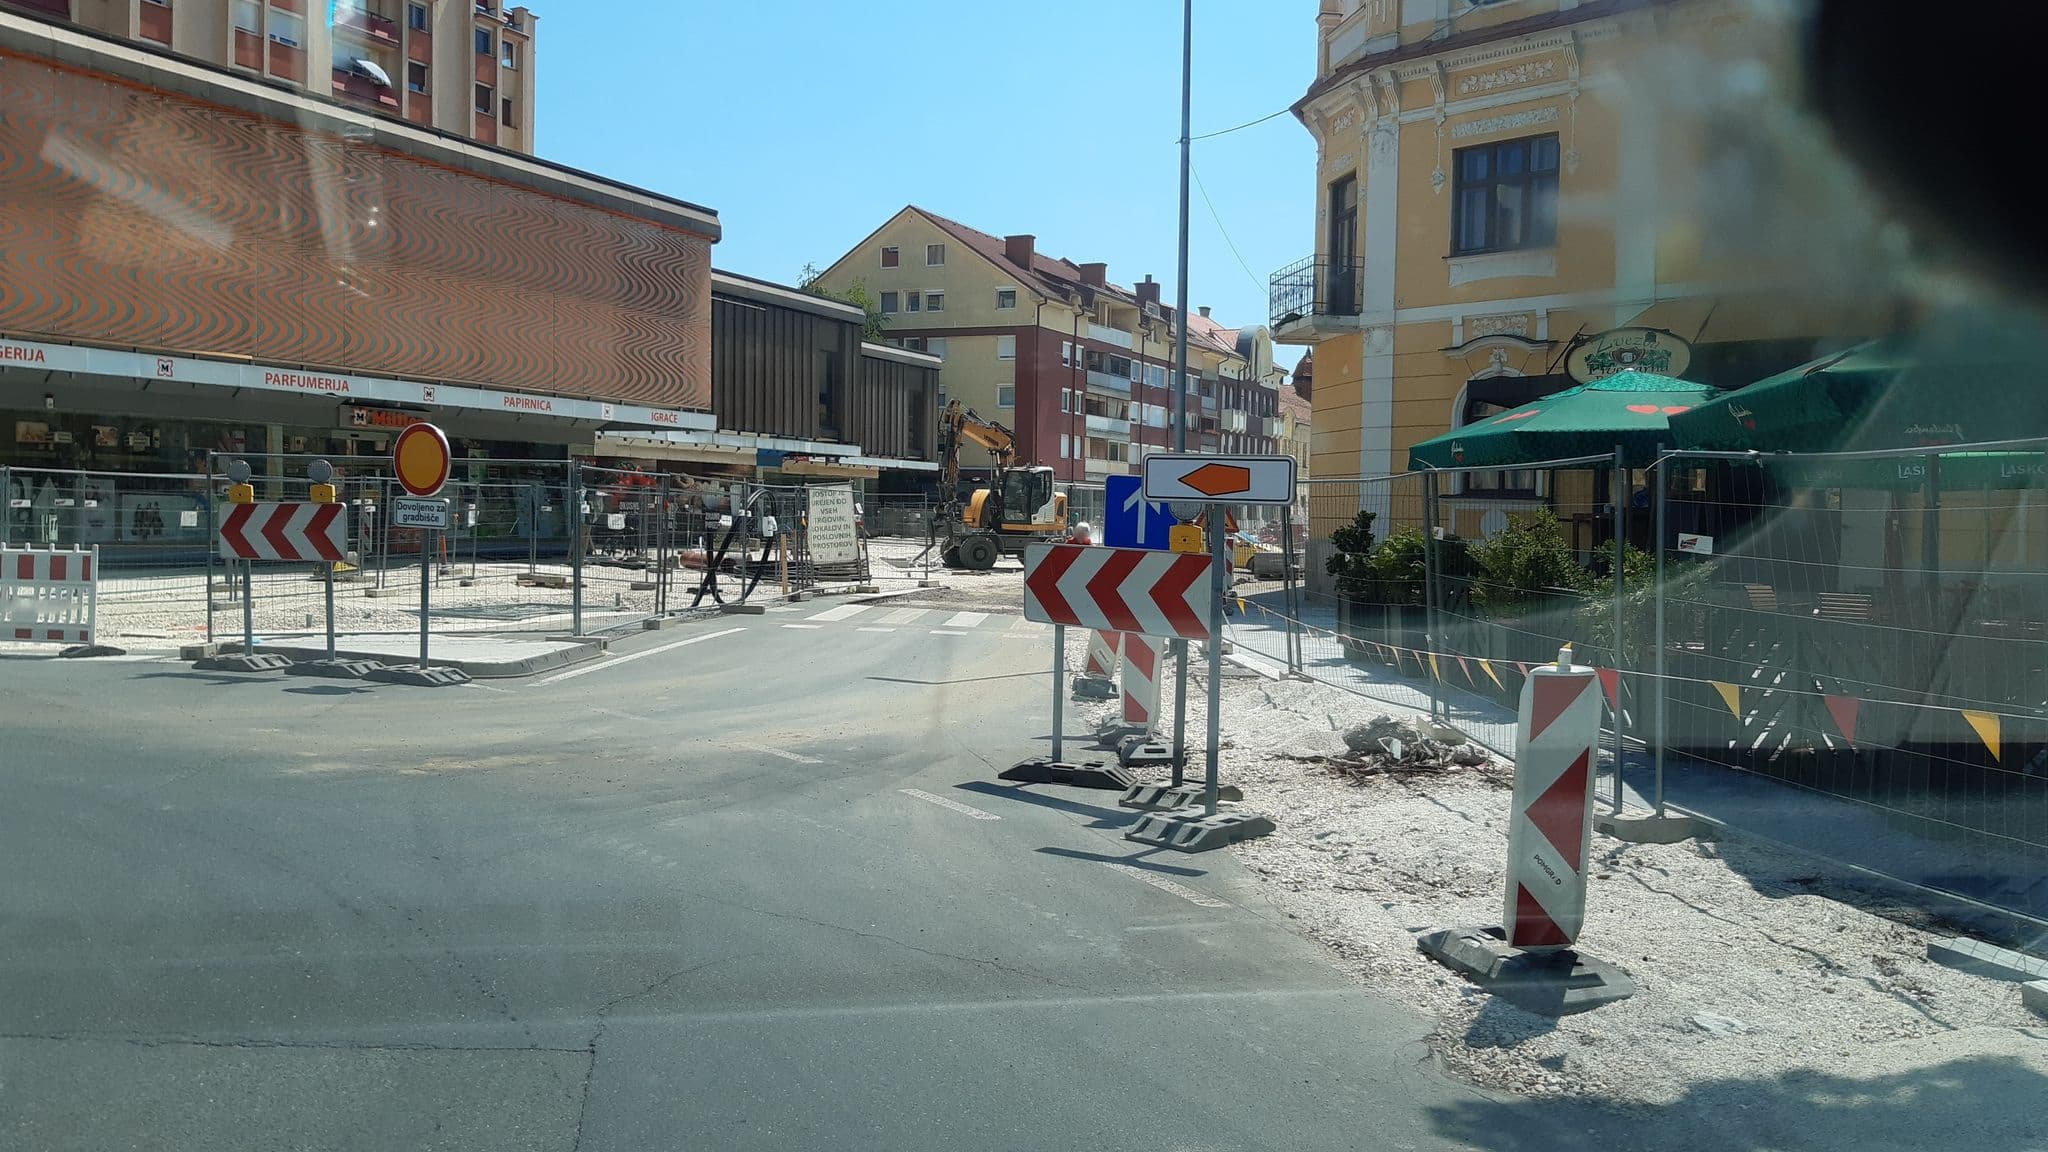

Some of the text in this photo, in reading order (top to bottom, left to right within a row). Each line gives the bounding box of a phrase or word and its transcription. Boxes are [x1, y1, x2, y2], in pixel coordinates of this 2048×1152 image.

[265, 372, 349, 392] PARFUMERIJA
[503, 396, 552, 411] PAPIRNICA
[651, 411, 678, 424] IGRAČE
[397, 501, 434, 513] Dovoljeno
[820, 507, 838, 515] VSEH
[402, 512, 440, 522] gradbišče
